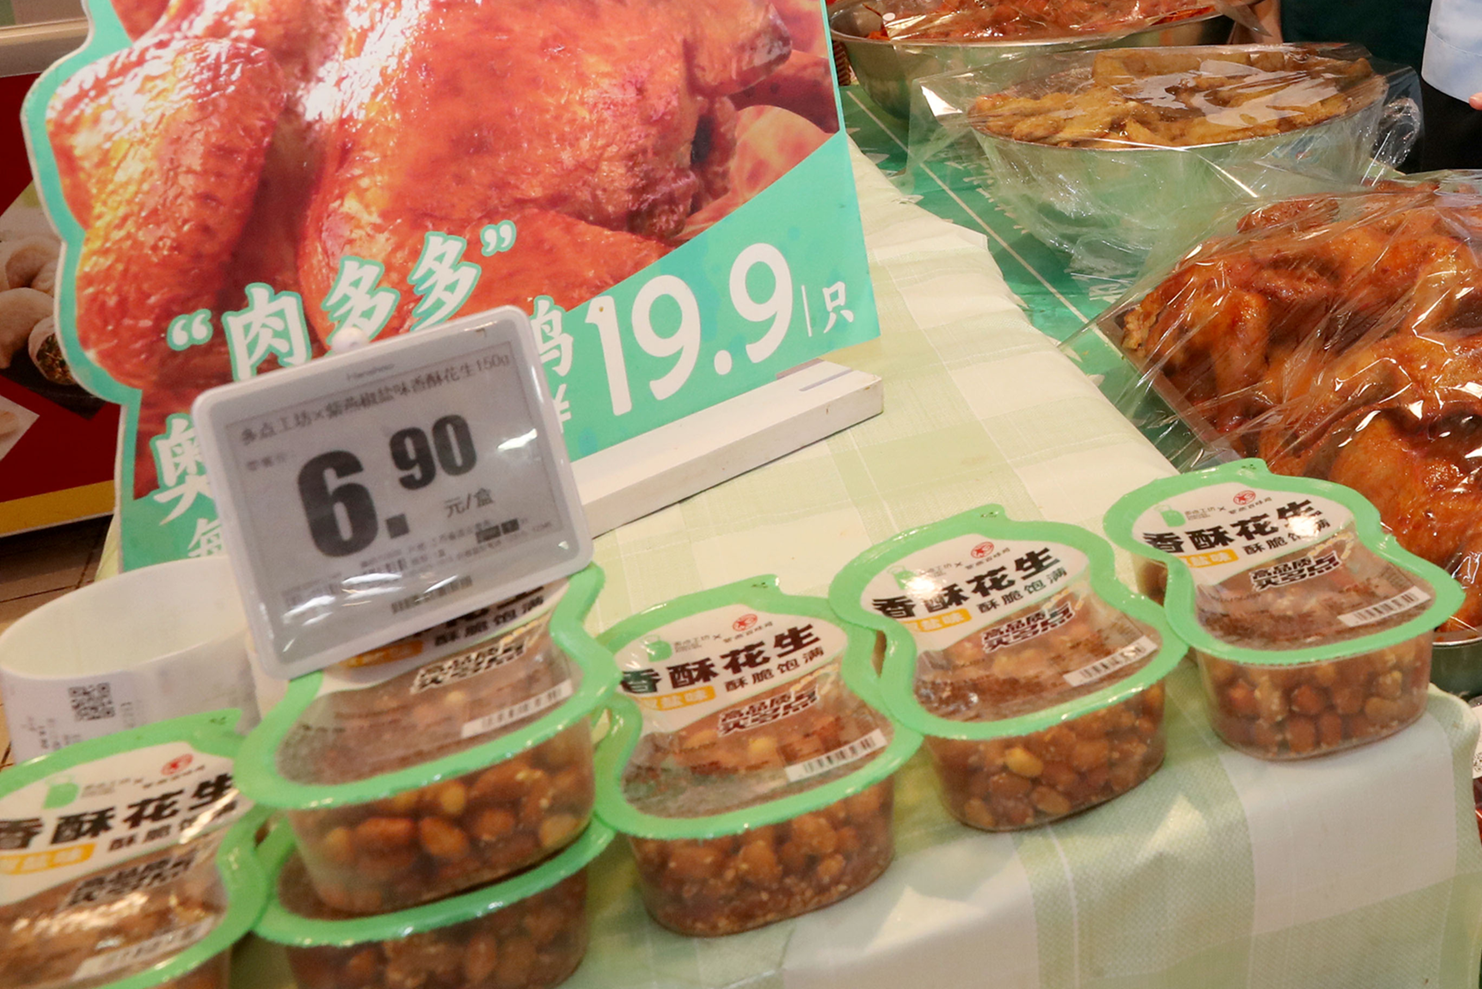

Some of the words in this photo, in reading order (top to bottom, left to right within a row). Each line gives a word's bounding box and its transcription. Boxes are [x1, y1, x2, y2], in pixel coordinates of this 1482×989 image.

[585, 241, 795, 418] 19.9
[444, 486, 495, 518] 元/盒
[1142, 499, 1323, 554] 香酥花生
[872, 547, 1061, 619] 香酥花生
[975, 566, 1068, 614] 酥脆饱满
[621, 623, 822, 694] 香酥花生
[724, 646, 824, 693] 酥脆饱满
[0, 773, 234, 850] 香酥花生
